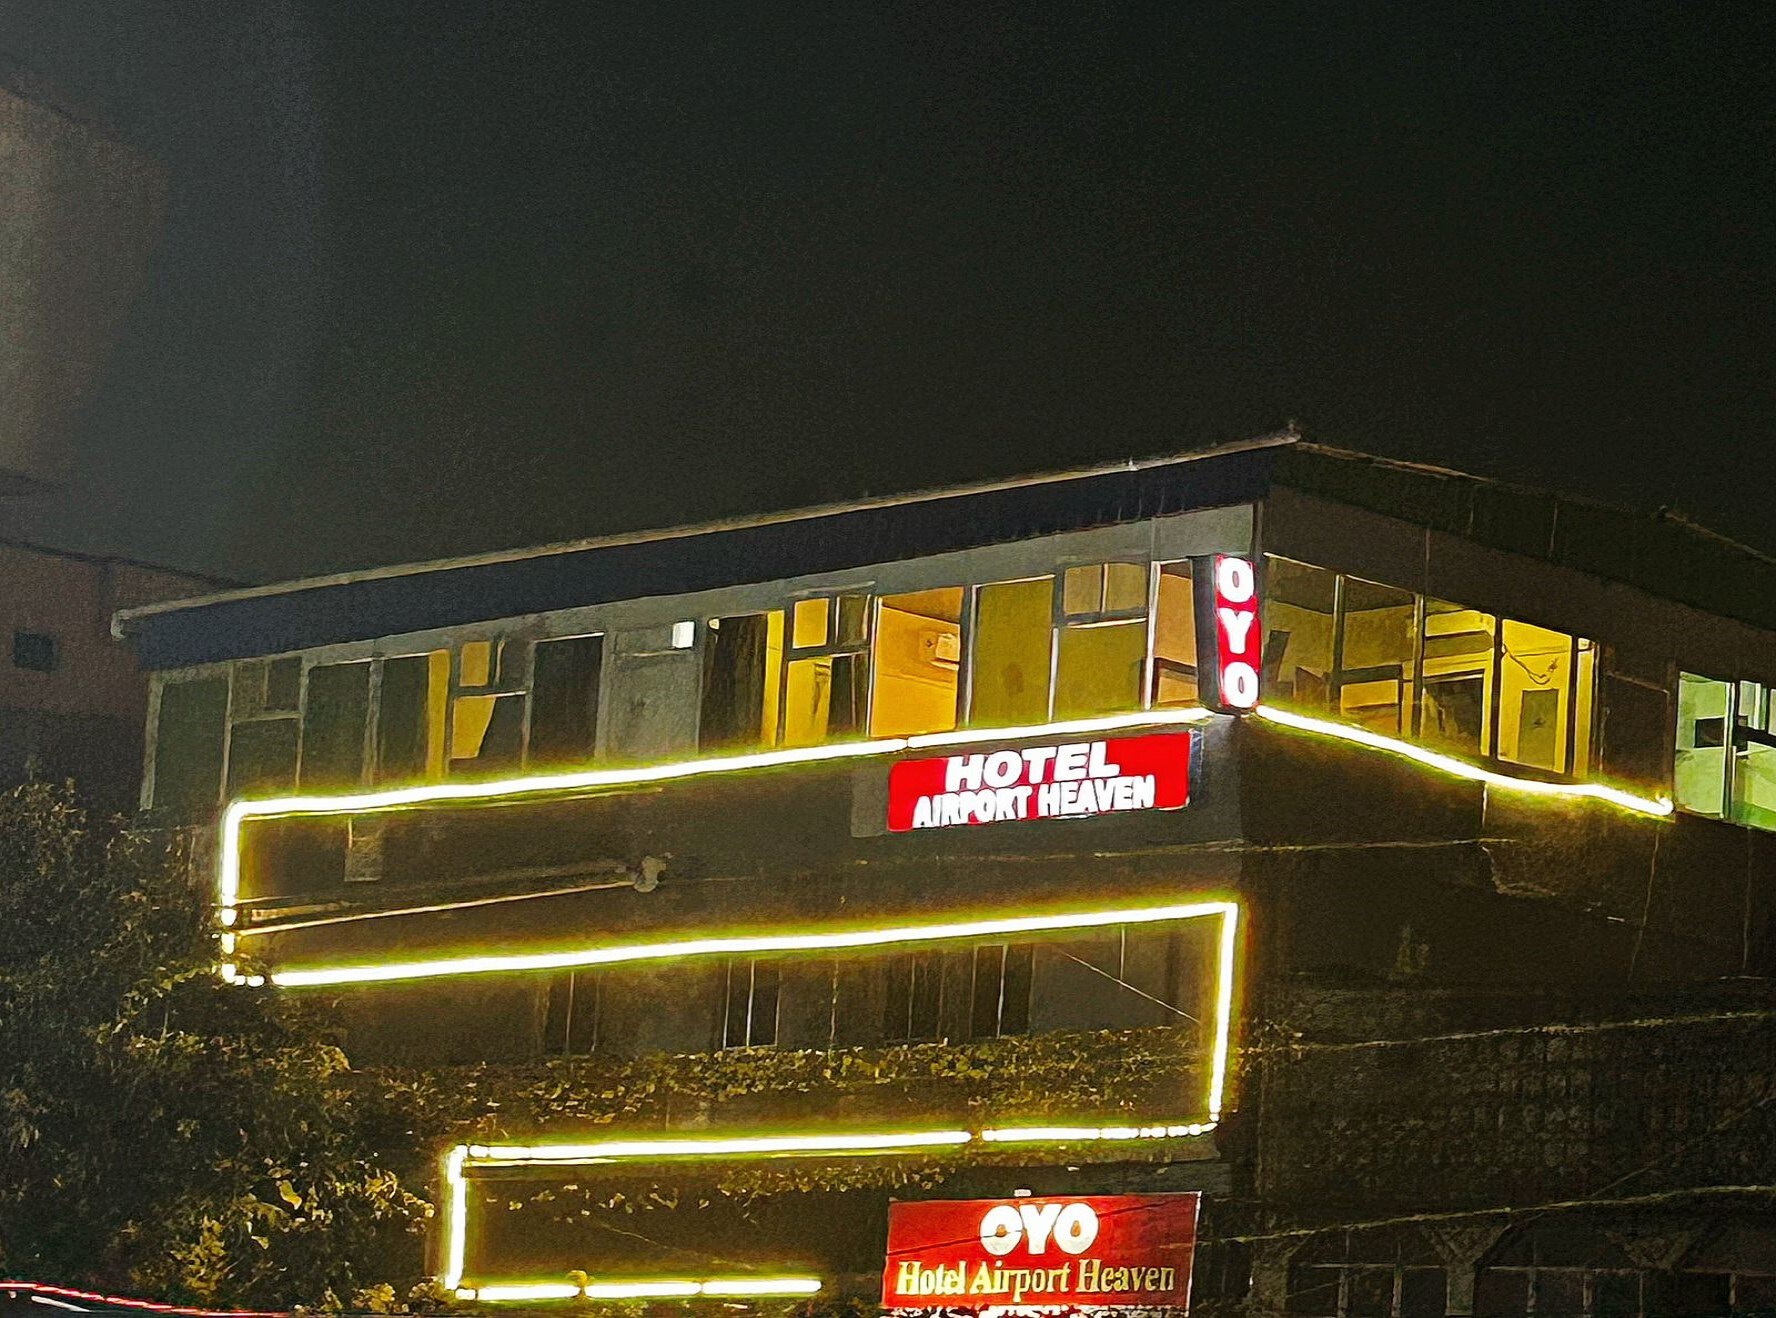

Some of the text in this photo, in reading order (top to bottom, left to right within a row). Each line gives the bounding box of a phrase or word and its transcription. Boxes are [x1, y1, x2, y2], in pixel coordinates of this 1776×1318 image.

[1217, 557, 1259, 708] OYO
[945, 741, 1120, 791] HOTEL
[912, 775, 1155, 829] AIRPORT HEAVEN
[979, 1202, 1100, 1256] OYO
[896, 1258, 1175, 1303] Hotel Airport Heaven
